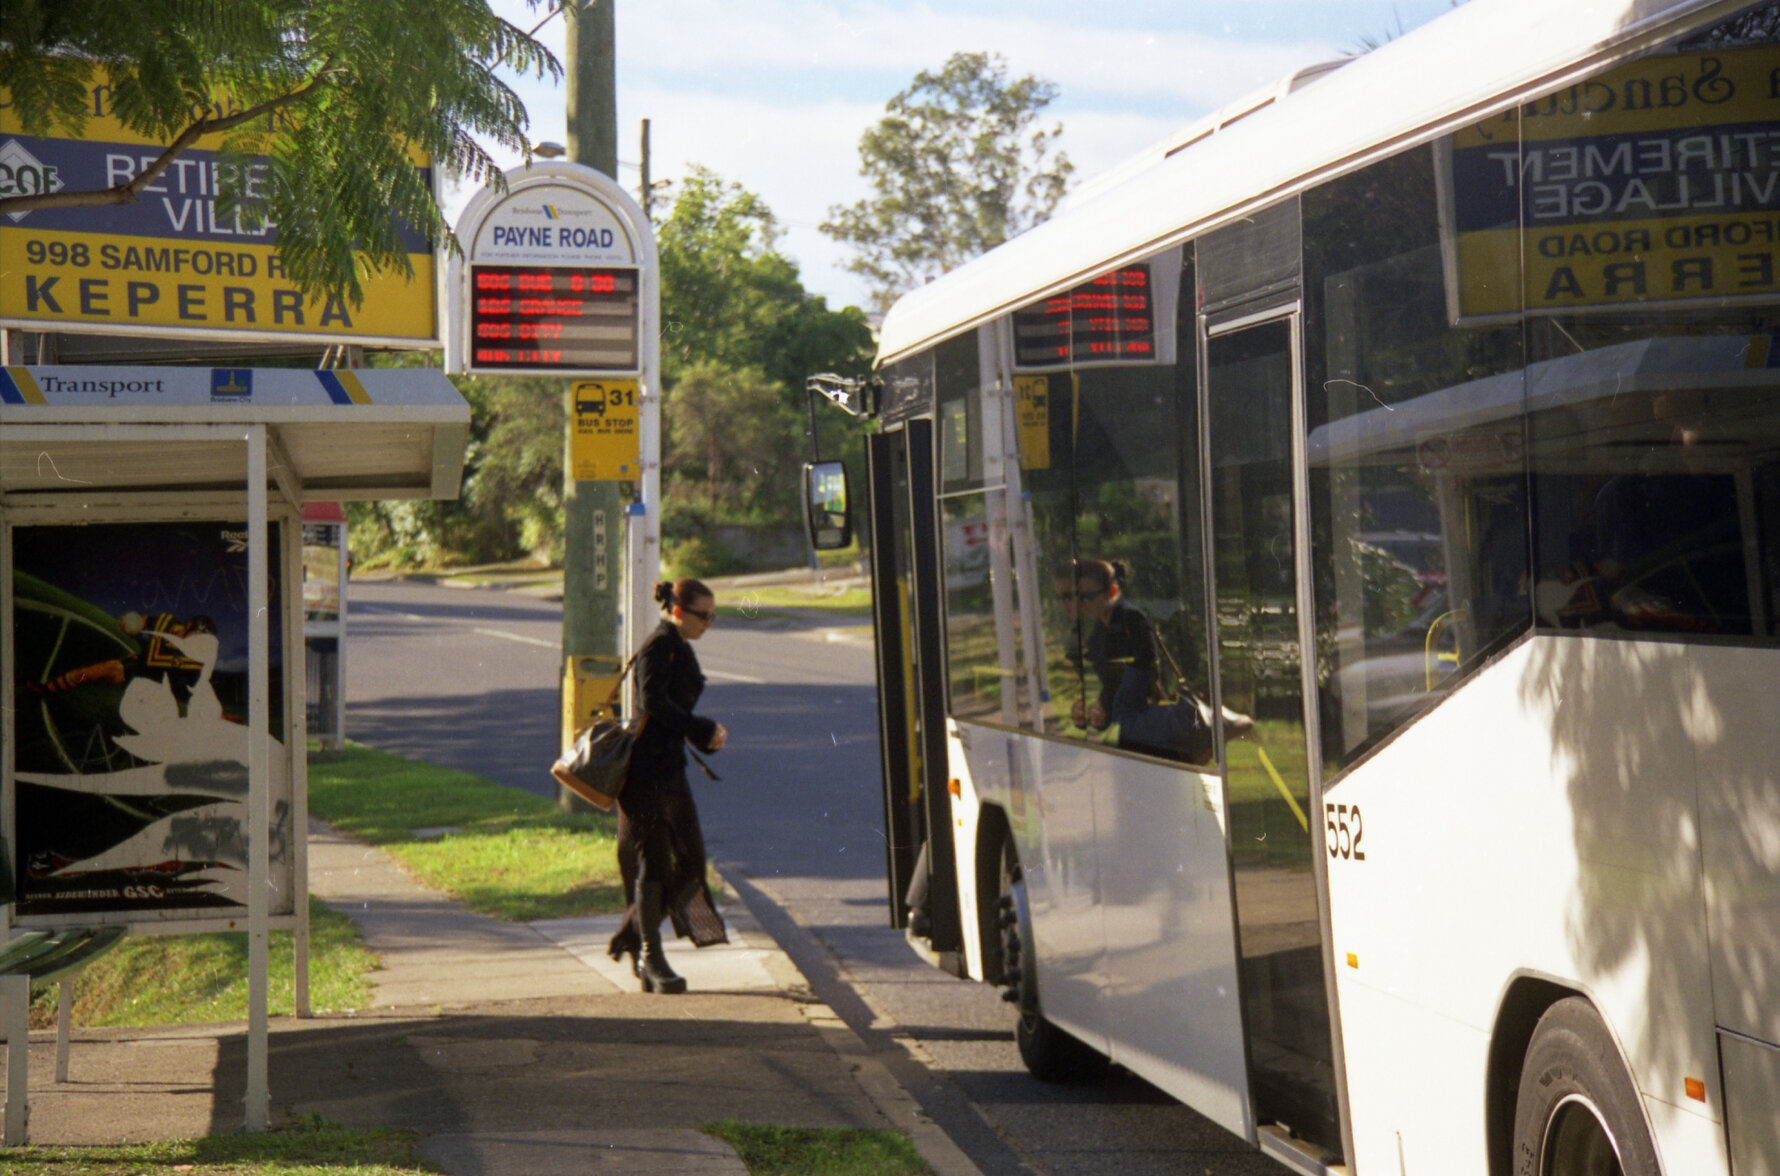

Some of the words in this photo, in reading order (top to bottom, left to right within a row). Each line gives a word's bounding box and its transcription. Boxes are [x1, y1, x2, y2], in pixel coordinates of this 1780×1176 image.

[106, 153, 279, 198] RETIRE
[493, 226, 553, 247] PAYNE
[559, 227, 614, 249] ROAD
[26, 240, 91, 268] 998
[101, 244, 258, 278] SAMFORD
[25, 275, 354, 328] KEPERRA
[40, 376, 165, 398] Transport
[609, 389, 634, 406] 31
[577, 418, 600, 428] BUS
[605, 418, 634, 428] STOP
[1325, 803, 1366, 861] 552
